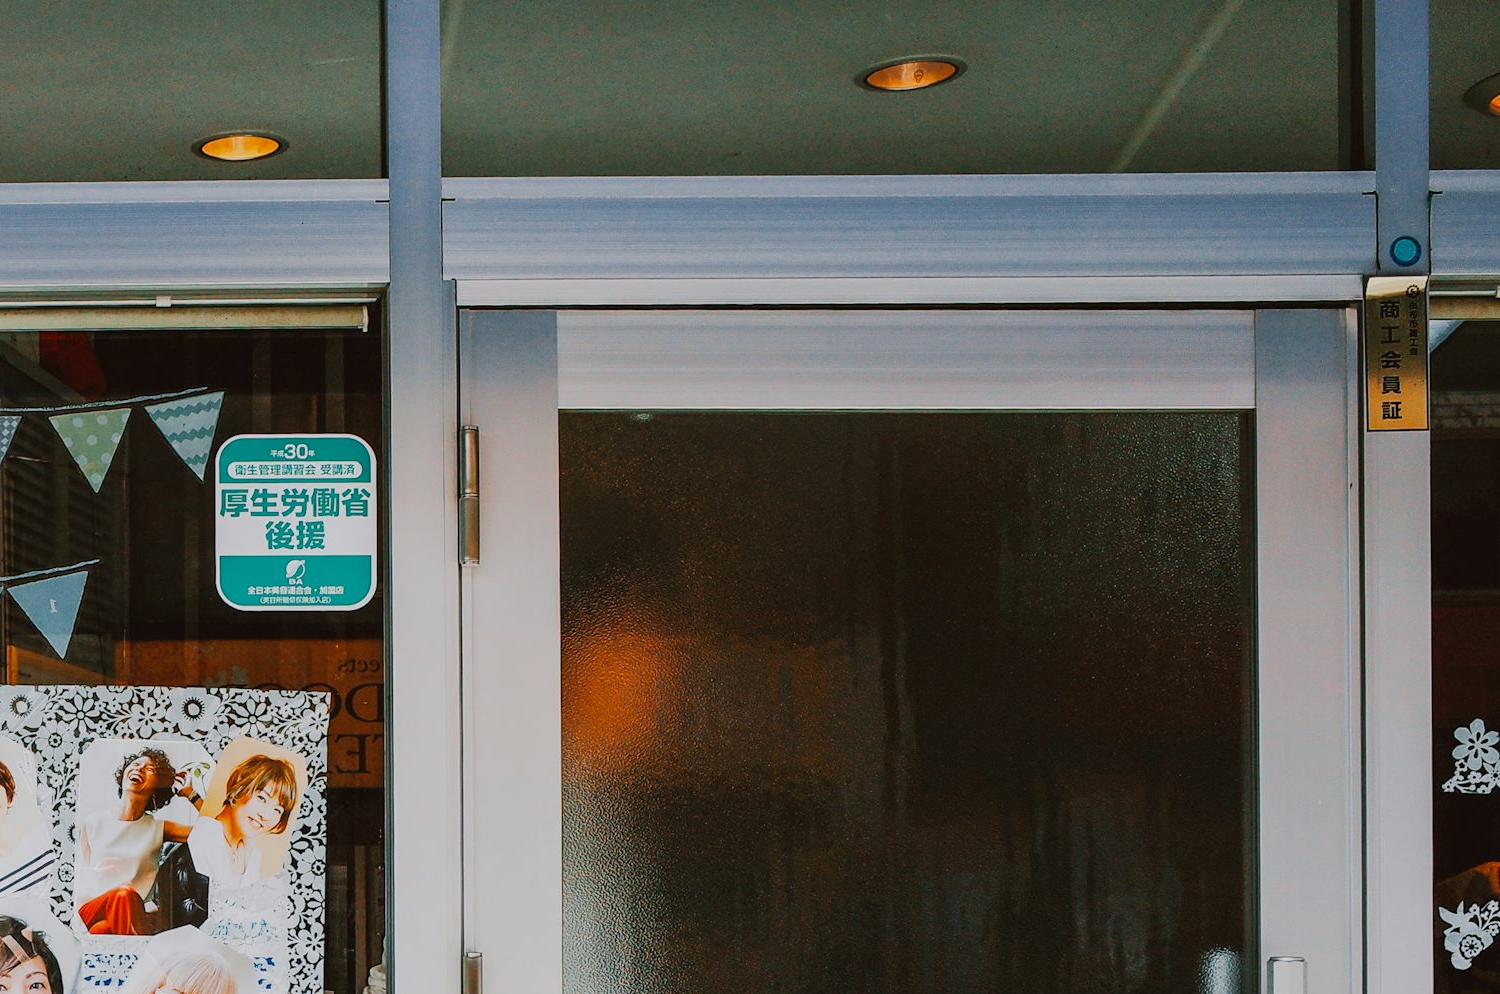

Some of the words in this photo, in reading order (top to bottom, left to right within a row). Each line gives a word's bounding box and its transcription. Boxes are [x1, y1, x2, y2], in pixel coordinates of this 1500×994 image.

[1379, 300, 1403, 420] 商工会員証
[219, 487, 372, 518] 厚生労働省
[265, 520, 326, 550] 後援
